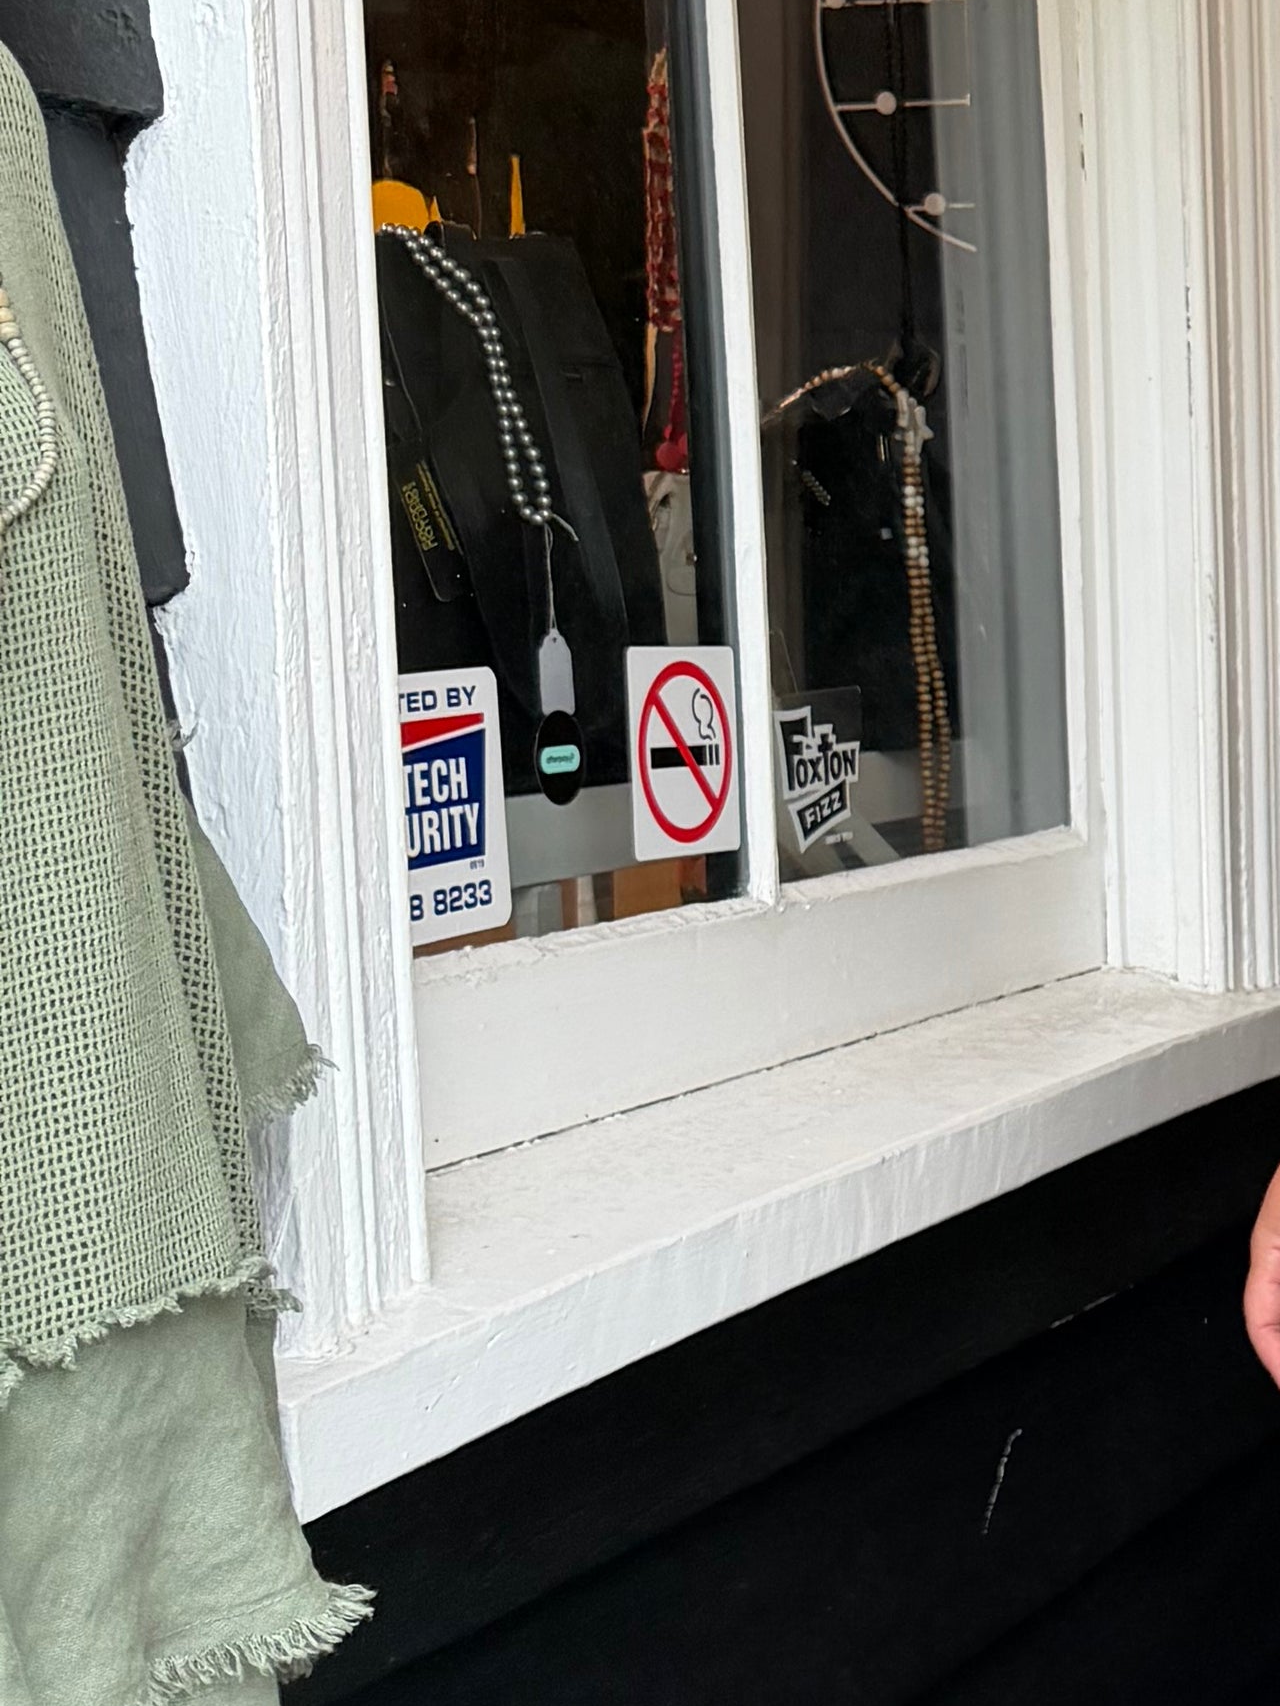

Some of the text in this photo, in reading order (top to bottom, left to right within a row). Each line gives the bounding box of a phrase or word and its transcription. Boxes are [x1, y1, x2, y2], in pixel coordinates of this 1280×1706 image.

[446, 685, 476, 708] BY
[780, 717, 856, 791] FOXTON
[403, 757, 468, 808] TECH
[405, 802, 479, 858] URITY
[805, 795, 842, 828] FIZZ
[433, 879, 492, 916] 8233
